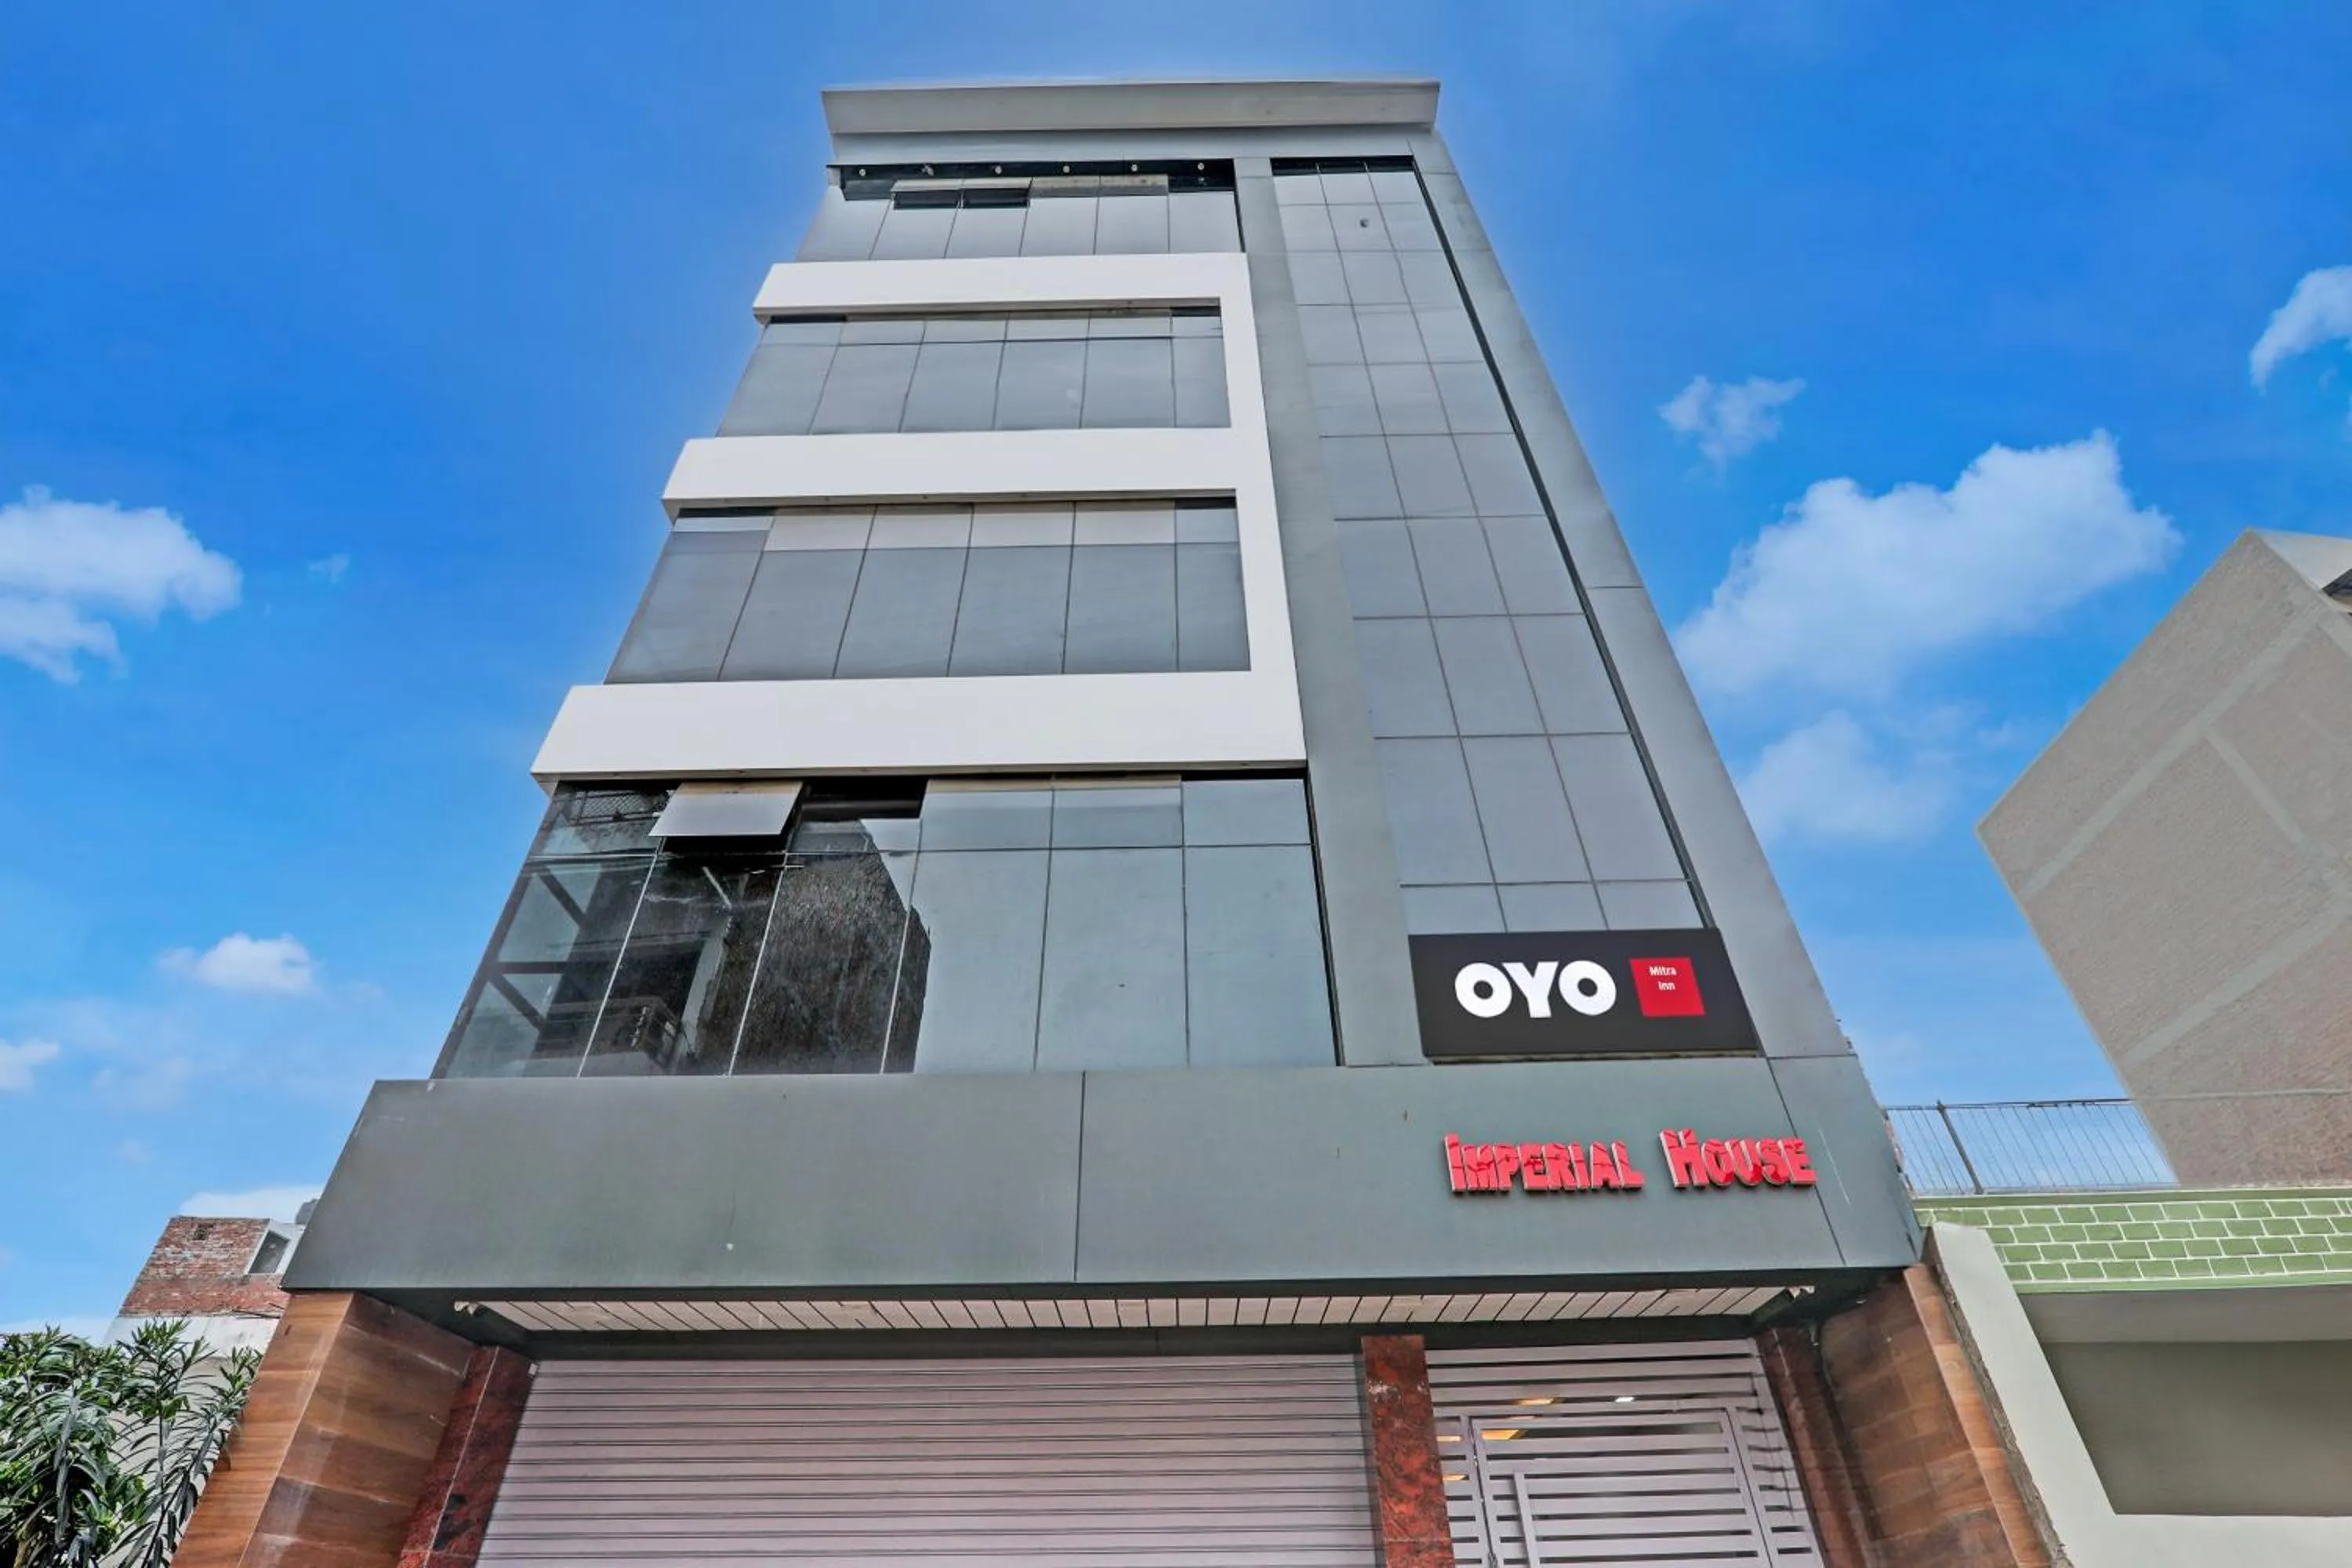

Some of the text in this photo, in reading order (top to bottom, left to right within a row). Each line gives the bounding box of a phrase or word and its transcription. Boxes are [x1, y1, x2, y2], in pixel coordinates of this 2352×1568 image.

[1649, 965, 1677, 976] Mitra
[1657, 981, 1676, 991] Inn
[1454, 960, 1617, 1018] OYO
[1444, 1128, 1817, 1192] IMPERIAL HOUSE
